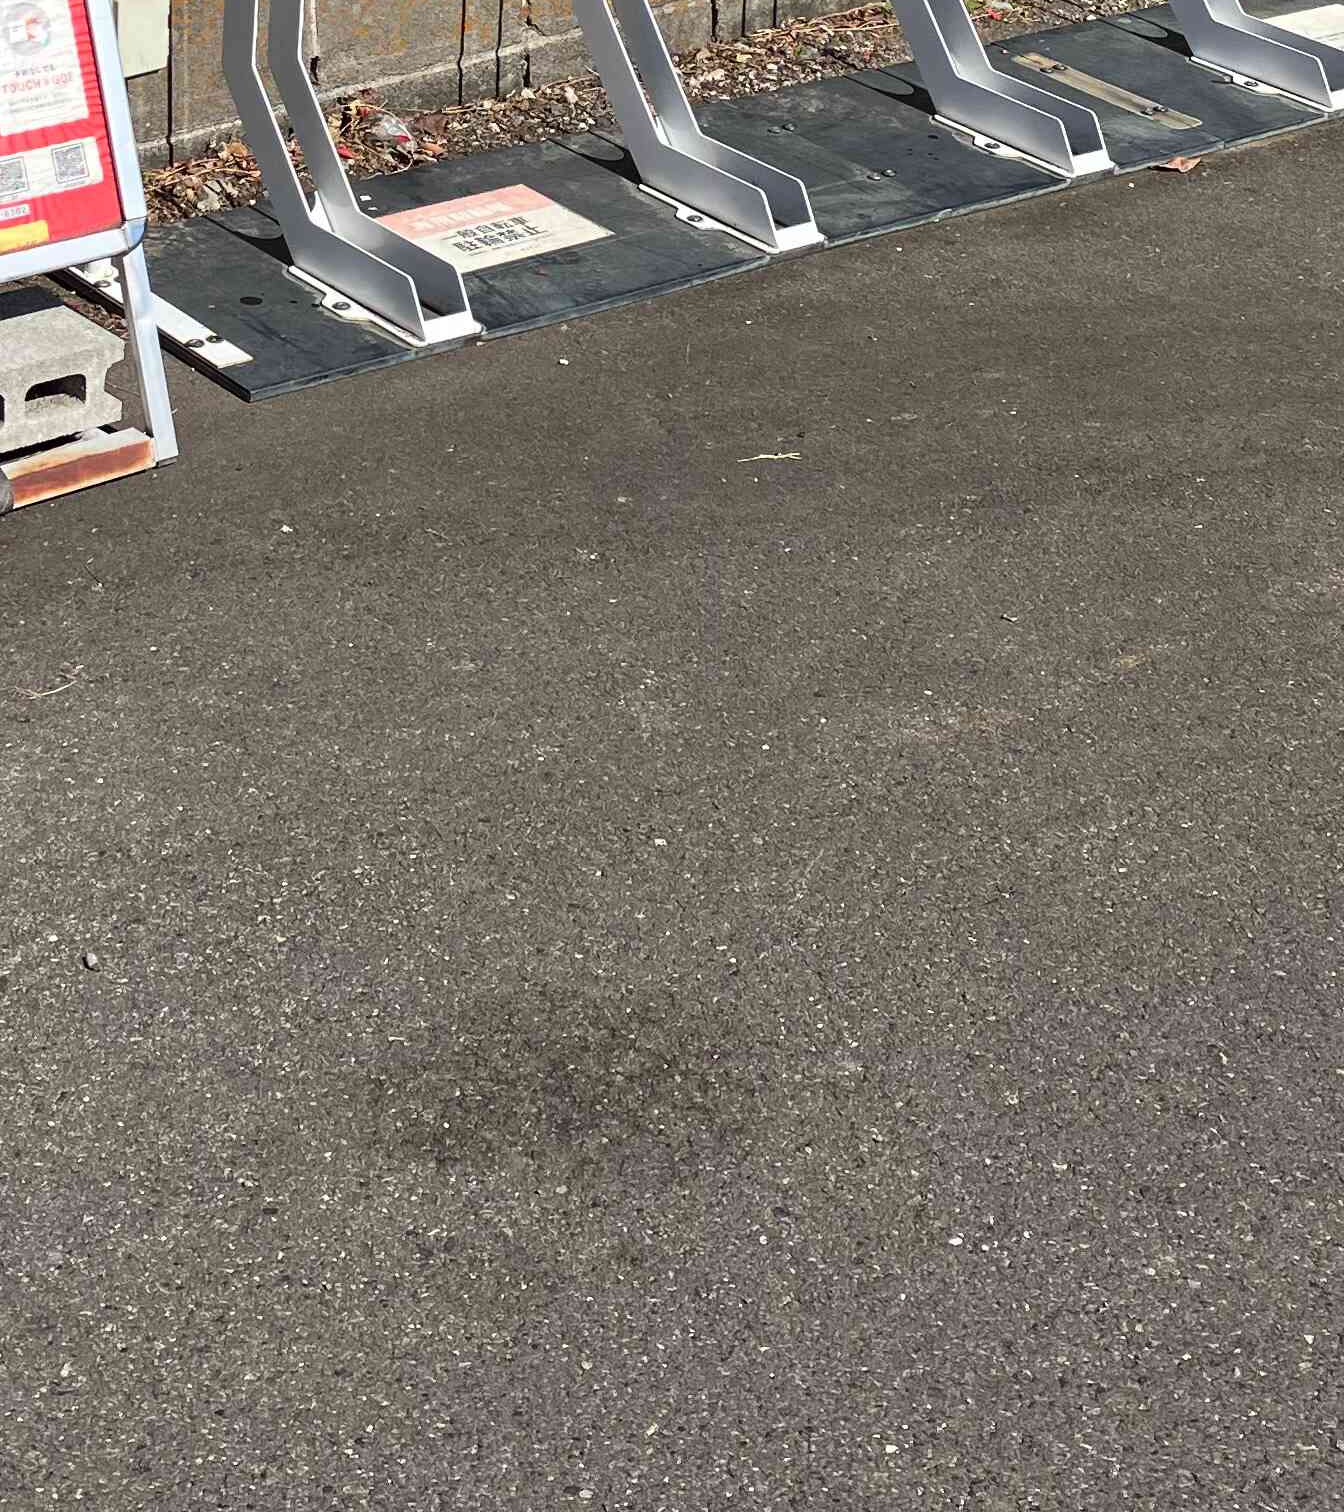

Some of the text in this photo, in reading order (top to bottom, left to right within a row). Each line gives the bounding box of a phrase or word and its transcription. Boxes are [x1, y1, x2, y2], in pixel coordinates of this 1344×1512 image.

[441, 215, 531, 241] 一般自転車
[452, 225, 547, 253] 駐輪禁止
